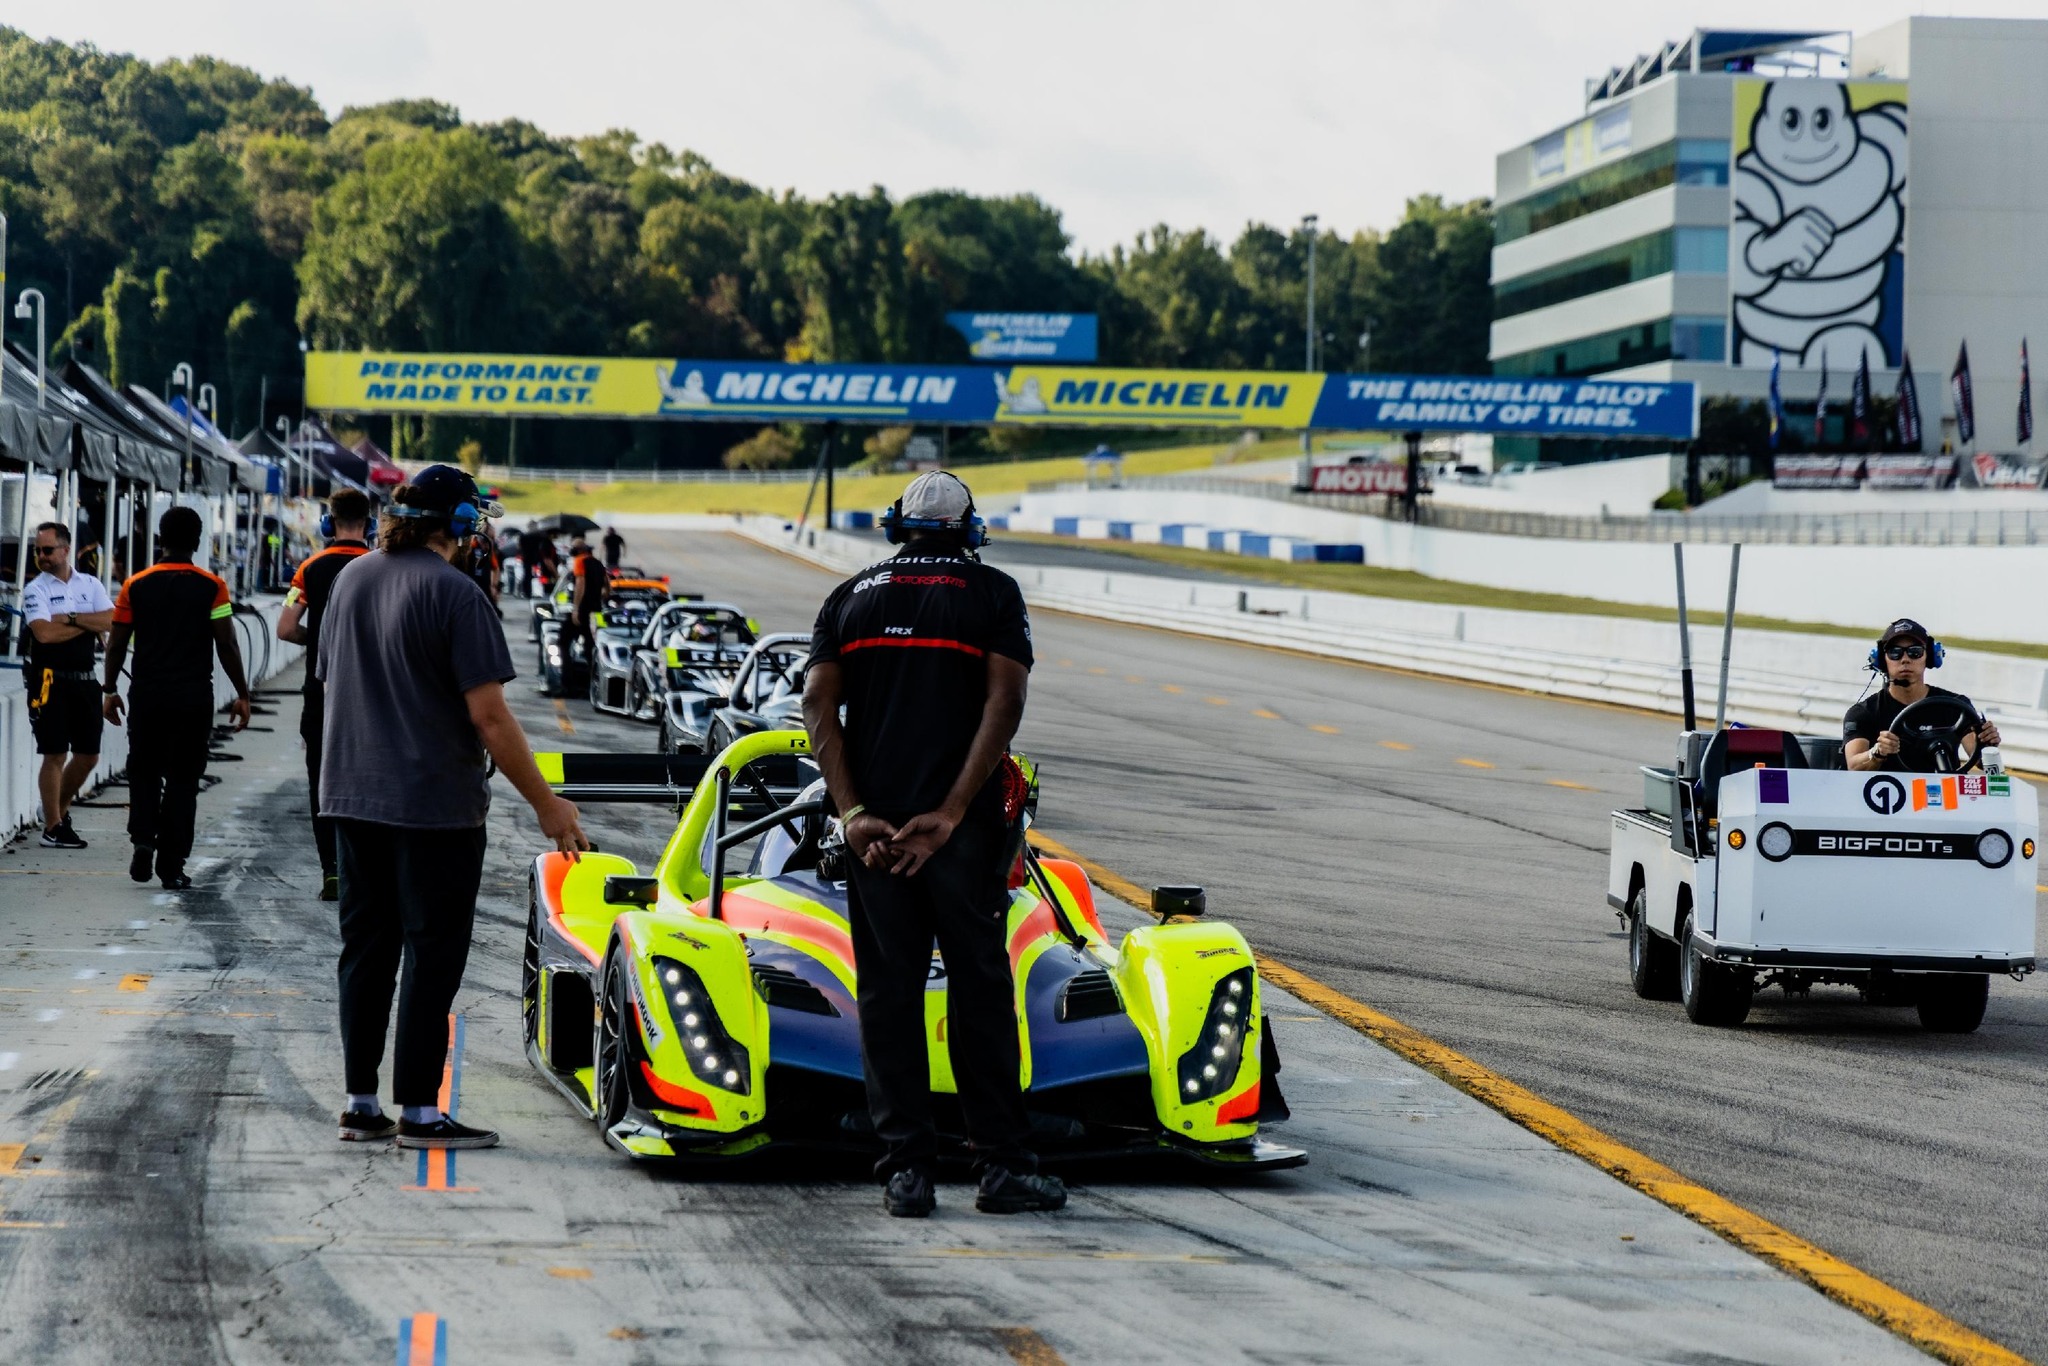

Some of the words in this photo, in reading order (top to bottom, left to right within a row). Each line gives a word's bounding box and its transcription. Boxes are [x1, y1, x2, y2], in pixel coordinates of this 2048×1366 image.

[360, 361, 602, 383] PERFORMANCE
[365, 384, 461, 401] MADE
[471, 385, 507, 401] TO
[515, 386, 594, 404] LAST.
[715, 372, 956, 403] MICHELIN
[1054, 380, 1289, 408] MICHELIN
[1348, 380, 1407, 400] THE
[1378, 402, 1495, 423] FAMILY
[1498, 406, 1541, 424] OF
[1548, 407, 1637, 427] TIRES.
[1315, 468, 1408, 491] MOTUL
[885, 627, 913, 635] HRX
